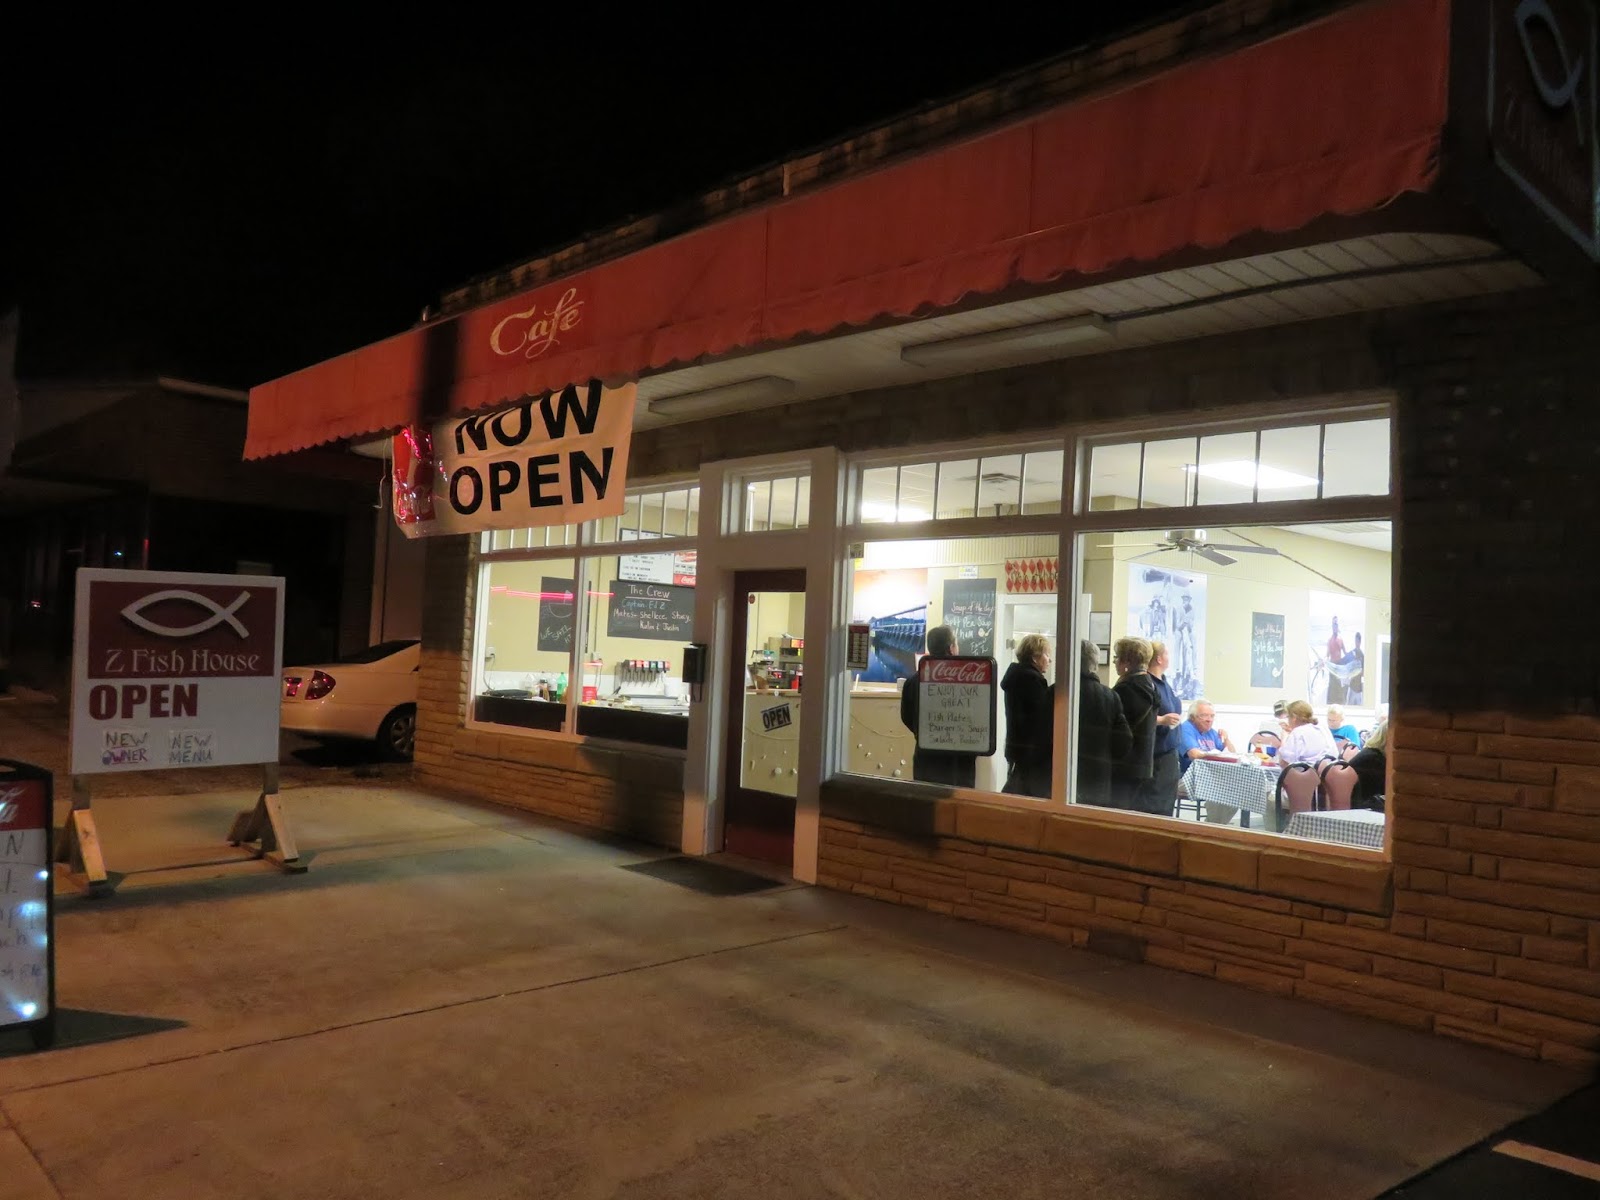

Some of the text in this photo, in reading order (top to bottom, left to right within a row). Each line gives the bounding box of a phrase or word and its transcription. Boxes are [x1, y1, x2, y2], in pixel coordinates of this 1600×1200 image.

[490, 287, 584, 358] Café
[455, 379, 602, 455] NOW
[449, 447, 614, 515] OPEN
[628, 584, 670, 598] The Crew
[105, 649, 260, 674] Z Fish House
[932, 661, 989, 682] Coca-Cola
[89, 683, 198, 720] OPEN
[940, 698, 970, 707] GREAT
[763, 706, 791, 729] OPEN
[105, 731, 148, 748] NEW
[171, 733, 212, 749] NEW
[168, 750, 213, 764] MENU
